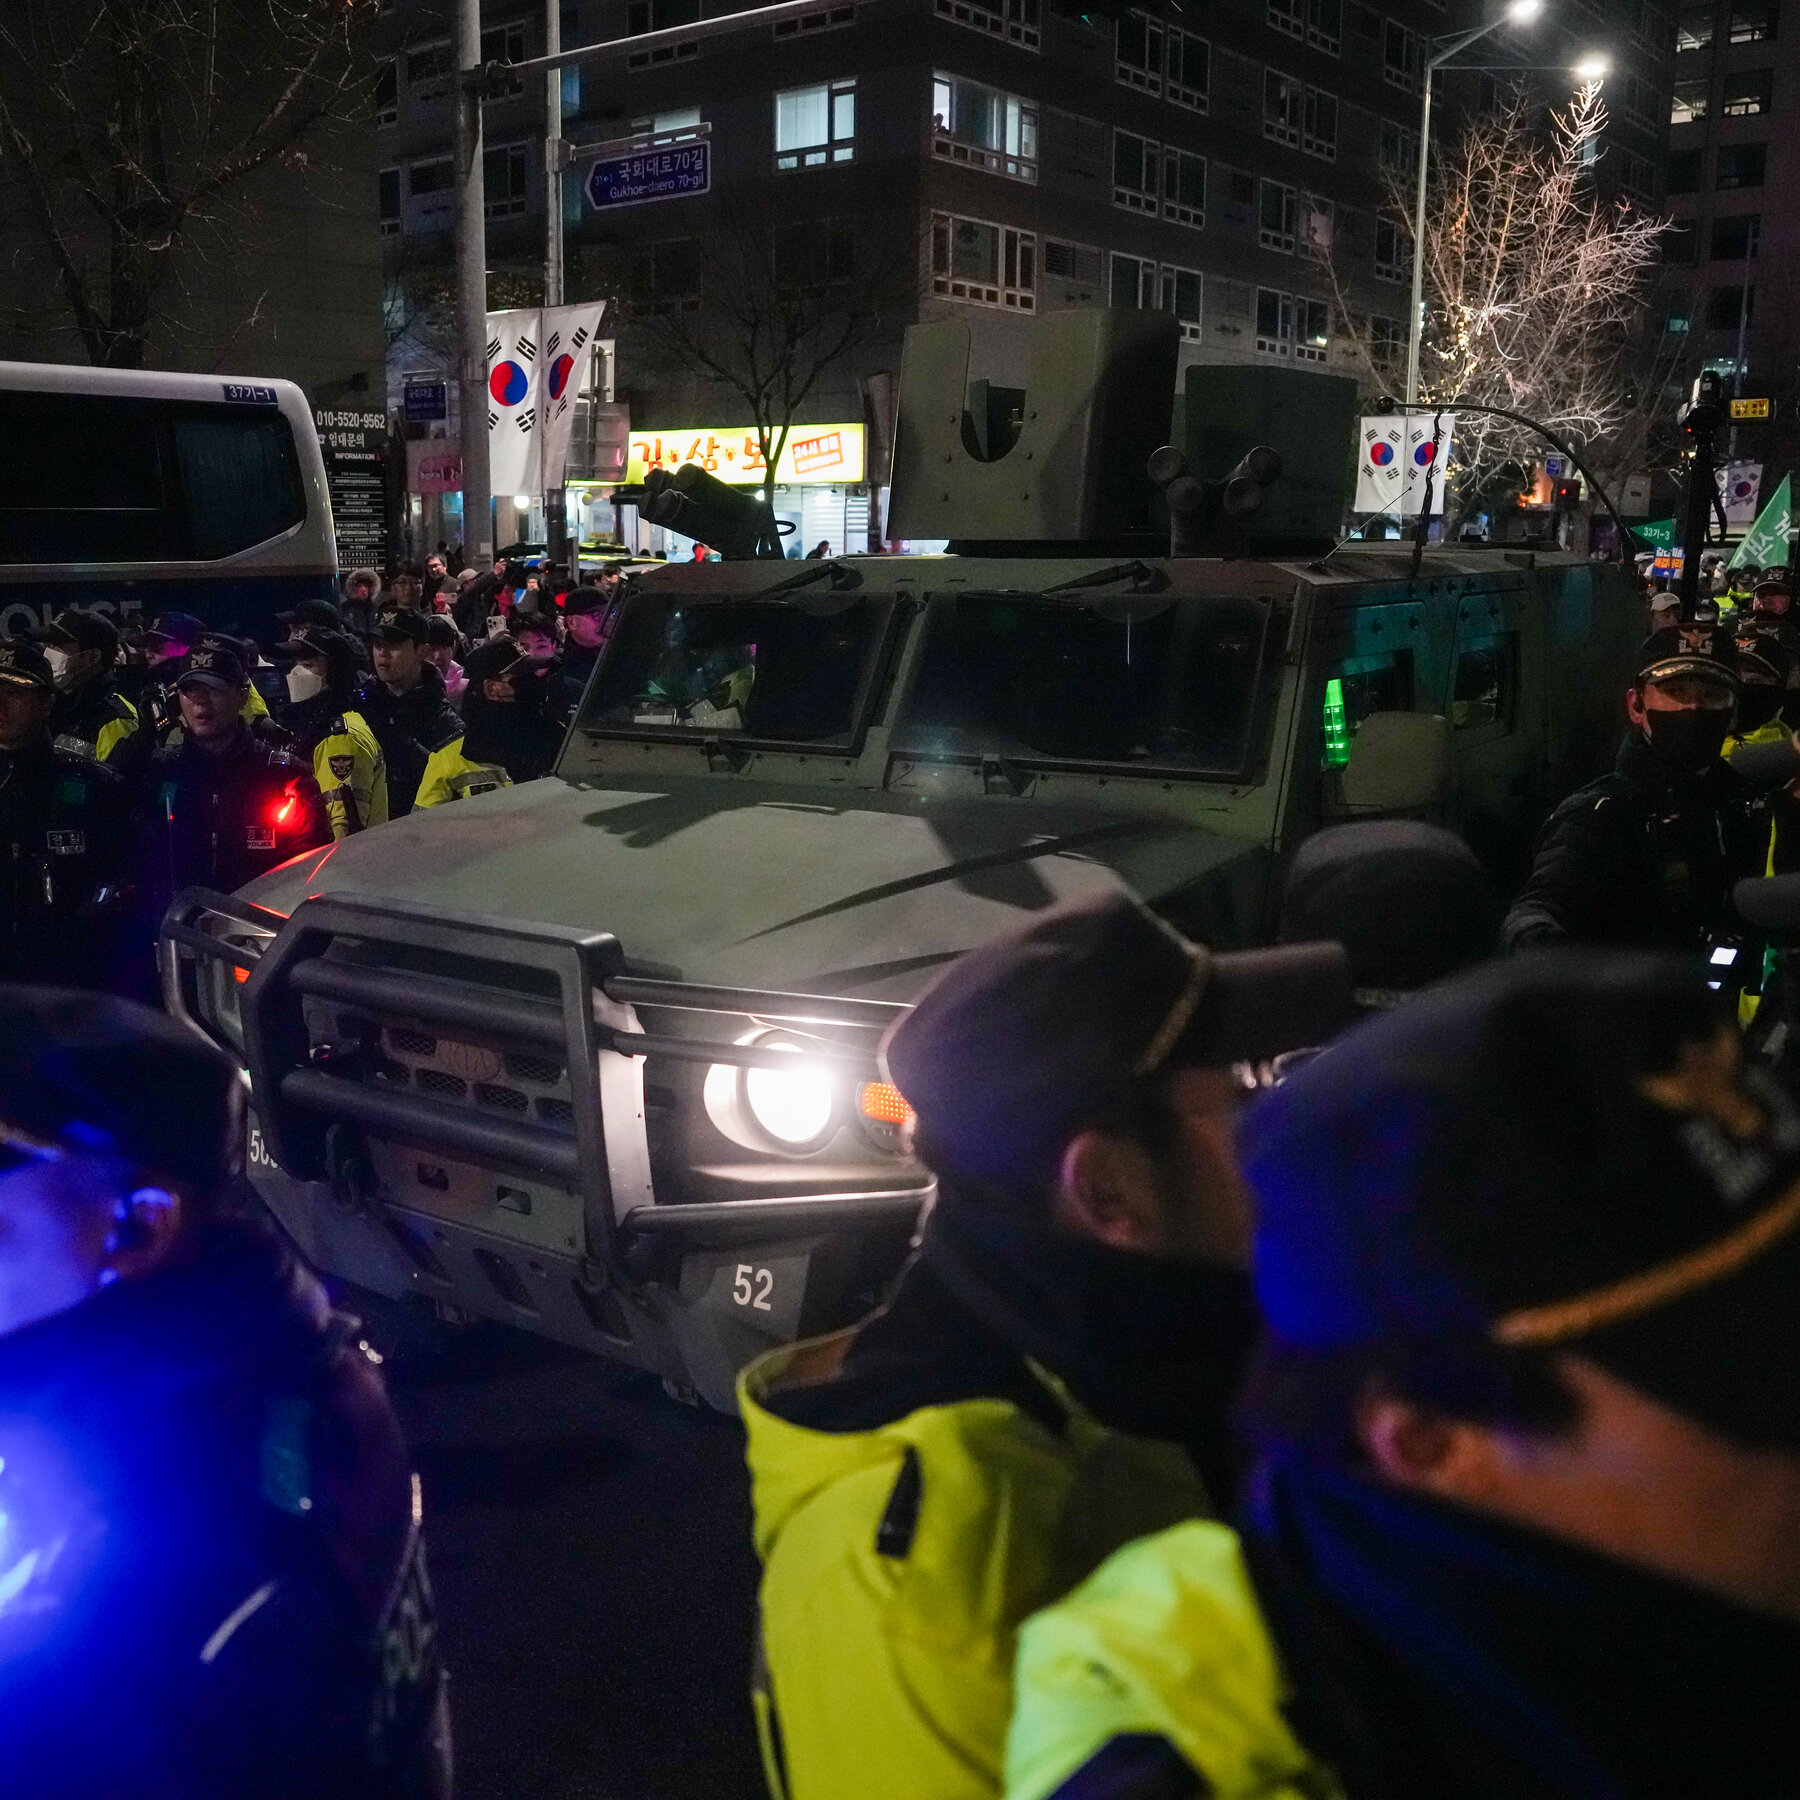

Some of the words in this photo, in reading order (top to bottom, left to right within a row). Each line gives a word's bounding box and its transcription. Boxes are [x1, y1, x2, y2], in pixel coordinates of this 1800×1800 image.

[618, 147, 704, 182] 국회대로70길
[609, 179, 675, 199] Gukhoe-daero
[677, 171, 704, 190] 70-gil
[229, 385, 271, 401] 37기-1
[316, 410, 386, 429] 010-5520-9562
[328, 432, 366, 448] 임대문의
[335, 452, 376, 461] INFORMATION
[1643, 527, 1670, 541] 33기-3
[732, 1263, 774, 1311] 52
